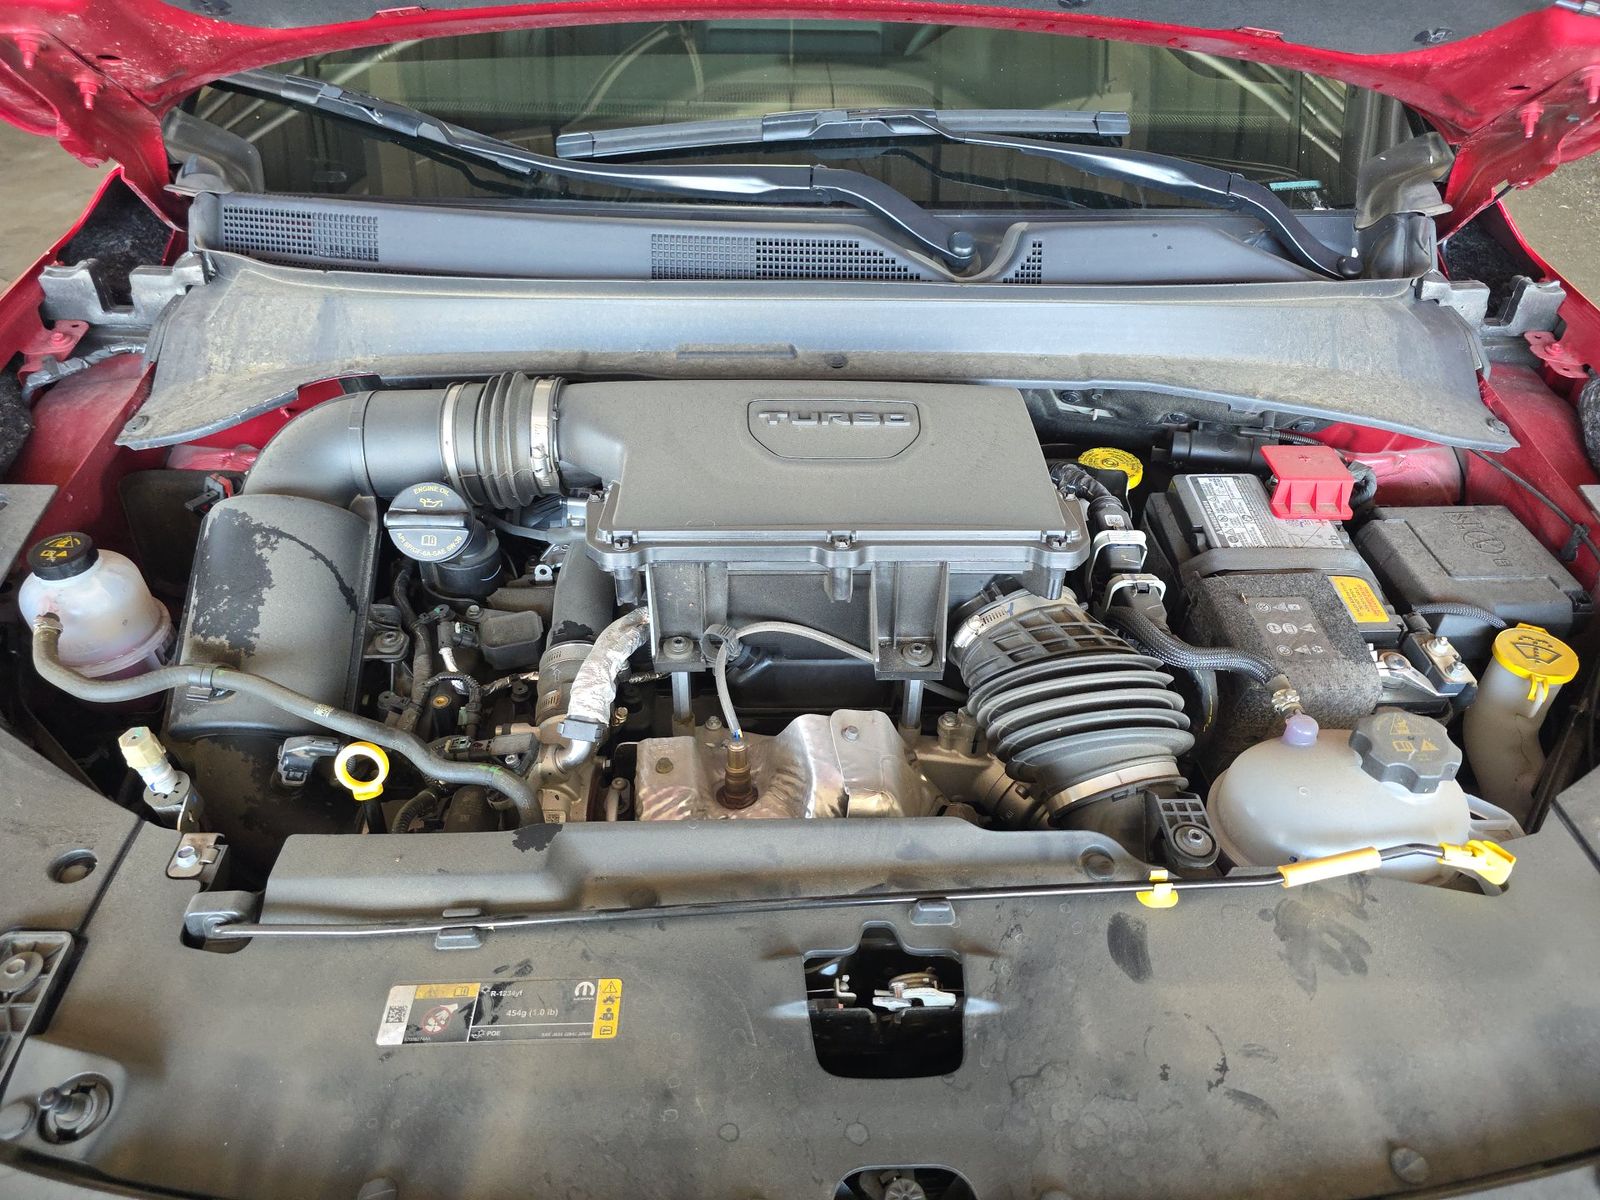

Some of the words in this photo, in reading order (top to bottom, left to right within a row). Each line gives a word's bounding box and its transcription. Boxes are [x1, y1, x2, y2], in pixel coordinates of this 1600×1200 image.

[758, 411, 911, 426] TURBO
[413, 485, 439, 495] ENGINE
[440, 488, 450, 497] OIL
[505, 1009, 527, 1018] 454g
